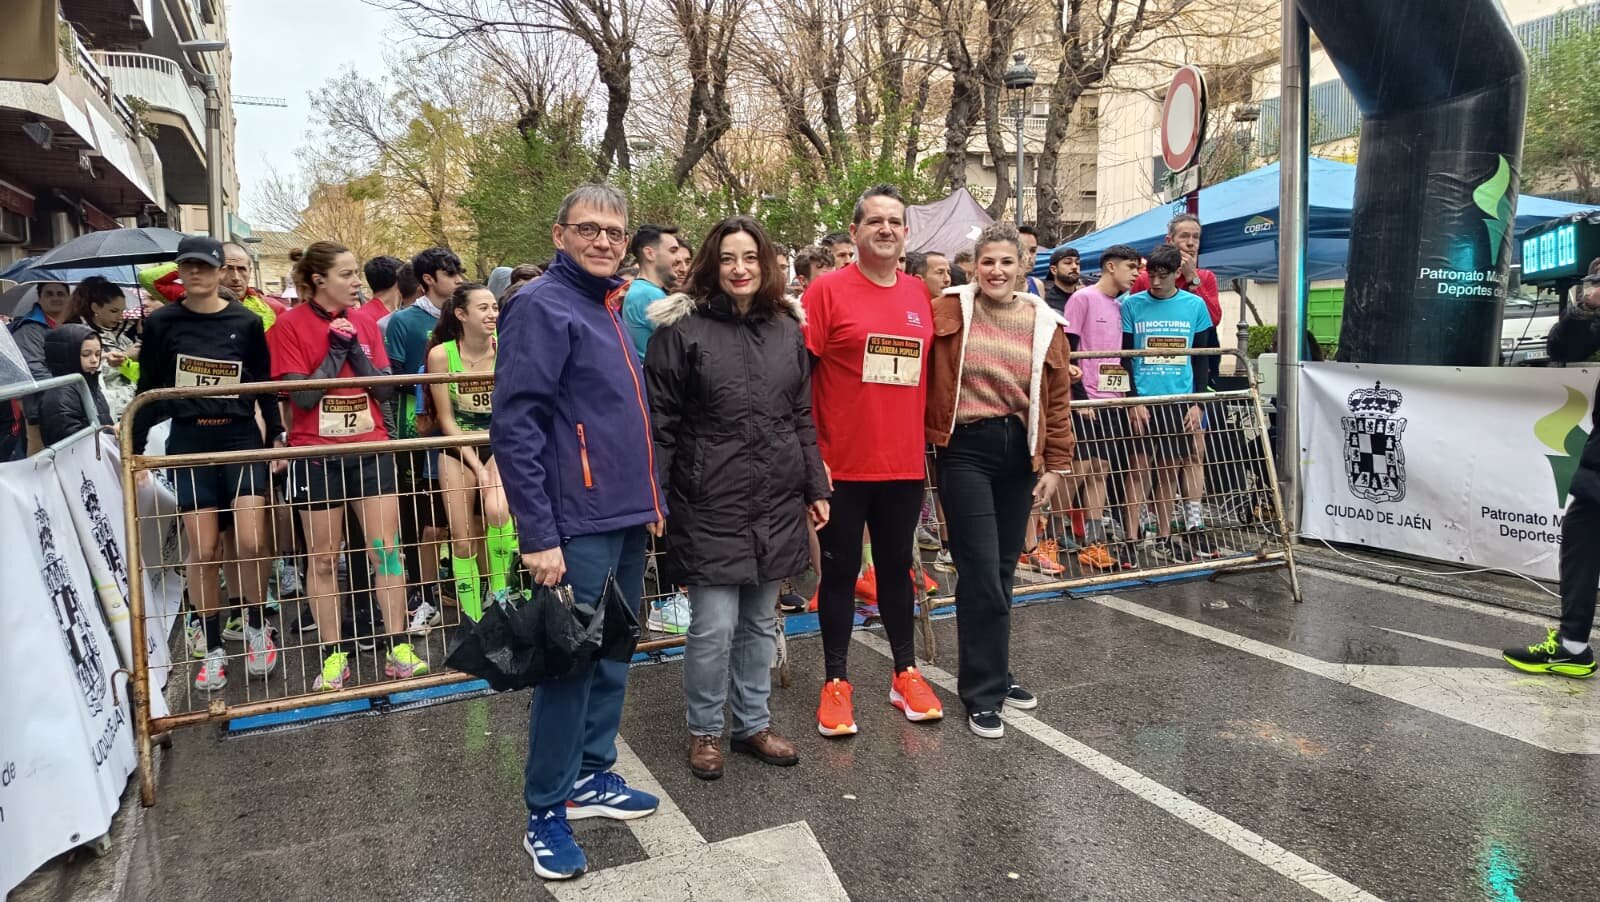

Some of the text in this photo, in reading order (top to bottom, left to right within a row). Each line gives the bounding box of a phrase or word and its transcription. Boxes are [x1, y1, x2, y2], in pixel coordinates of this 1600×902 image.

[1420, 267, 1484, 281] Patronato
[1437, 282, 1492, 298] Deportes
[1146, 320, 1191, 328] NOCTURNA
[875, 346, 898, 354] CARRERA
[900, 348, 919, 357] POPULAR
[187, 365, 211, 375] CARRERA
[212, 367, 237, 376] POPULAR
[894, 357, 898, 374] 1
[196, 375, 221, 386] 157
[1107, 375, 1122, 386] 579
[343, 413, 357, 428] 12
[1324, 504, 1432, 531] CIUDAD DE JAÉN
[1481, 506, 1548, 526] Patronato
[1499, 524, 1565, 545] Deportes
[2, 761, 16, 787] de
